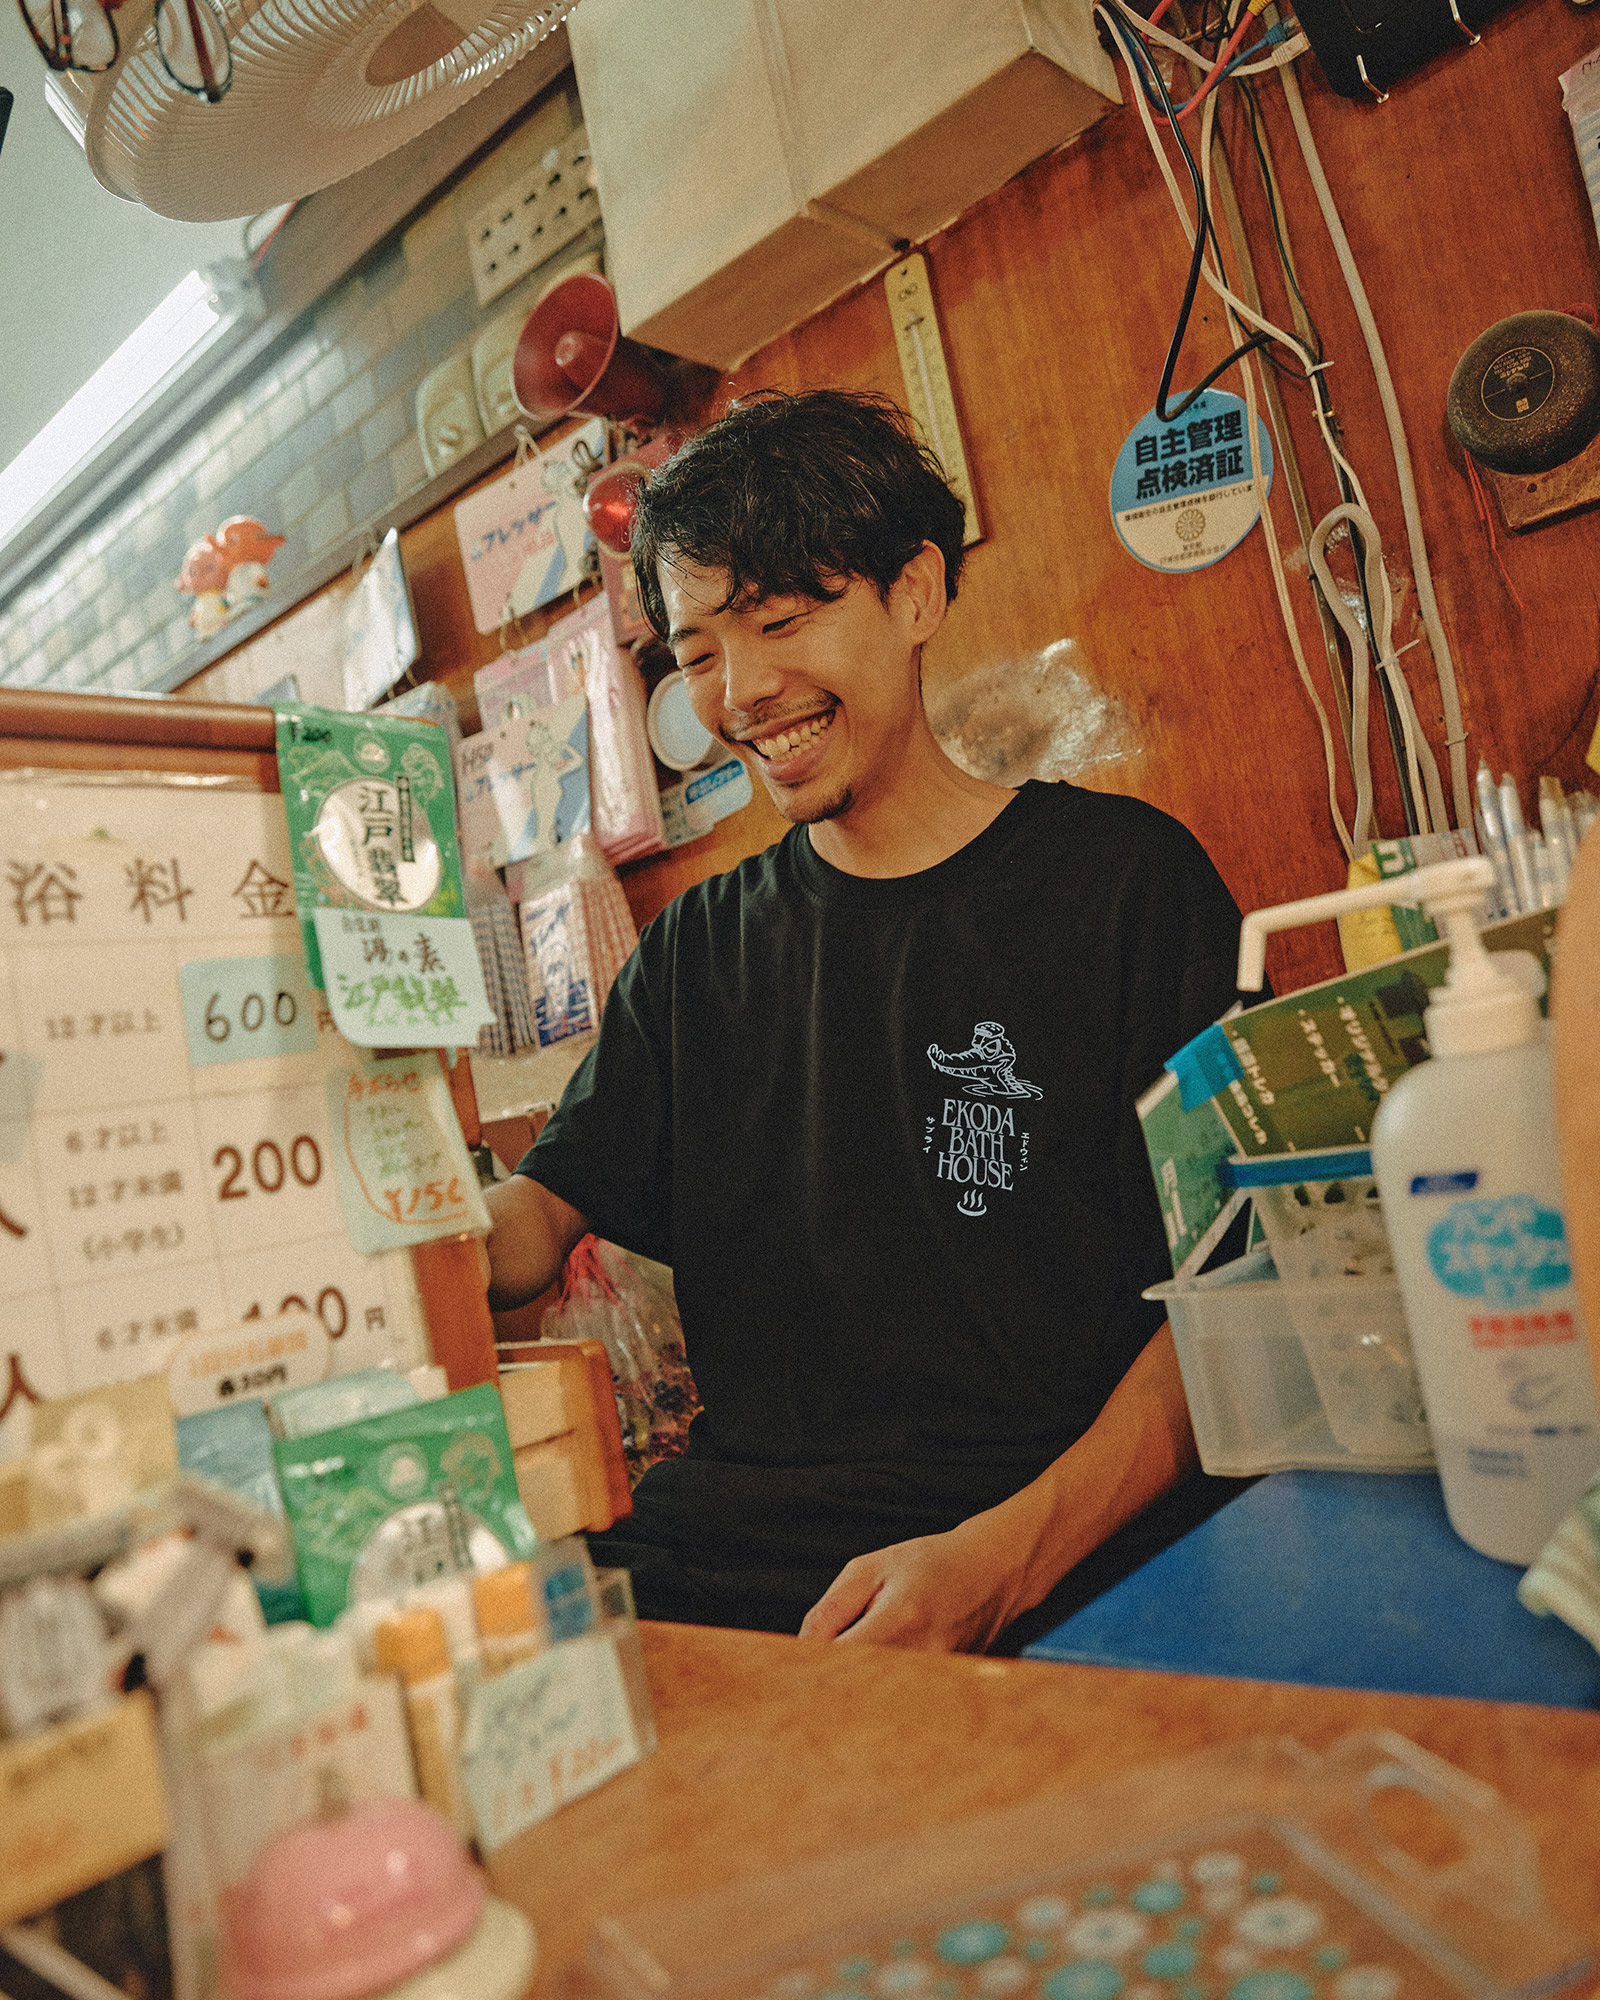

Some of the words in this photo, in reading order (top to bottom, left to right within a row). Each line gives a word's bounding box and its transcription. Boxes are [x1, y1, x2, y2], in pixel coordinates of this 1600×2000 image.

[1135, 409, 1243, 466] 自主管理
[1136, 445, 1244, 500] 点検済証
[205, 993, 297, 1043] 600
[941, 1098, 1015, 1137] EKODA
[213, 1135, 322, 1202] 200
[948, 1126, 1005, 1162] BATH
[937, 1151, 1014, 1191] HOUSE
